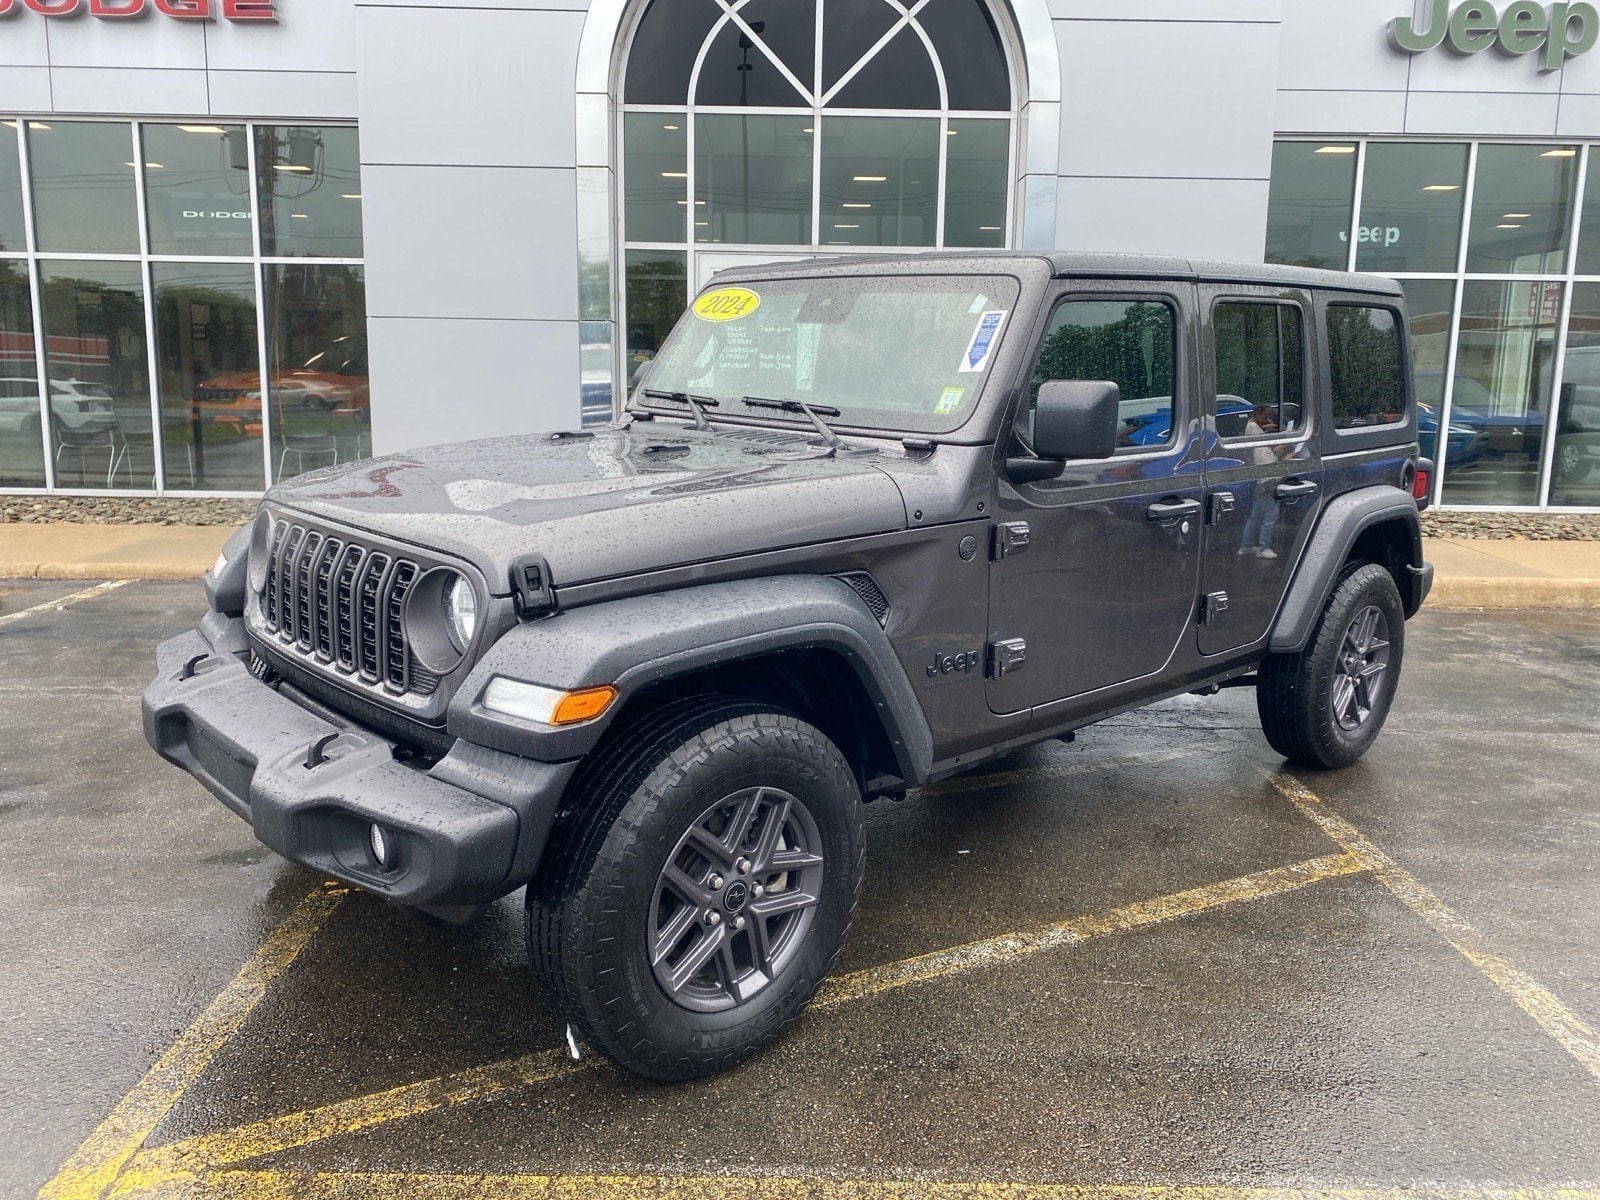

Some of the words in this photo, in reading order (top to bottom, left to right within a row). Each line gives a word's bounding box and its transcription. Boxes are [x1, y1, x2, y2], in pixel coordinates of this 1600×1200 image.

[0, 0, 275, 20] ODGE
[1388, 0, 1599, 72] Jeep
[182, 210, 252, 219] DODG
[701, 295, 753, 314] 2024
[926, 650, 979, 678] Jeep
